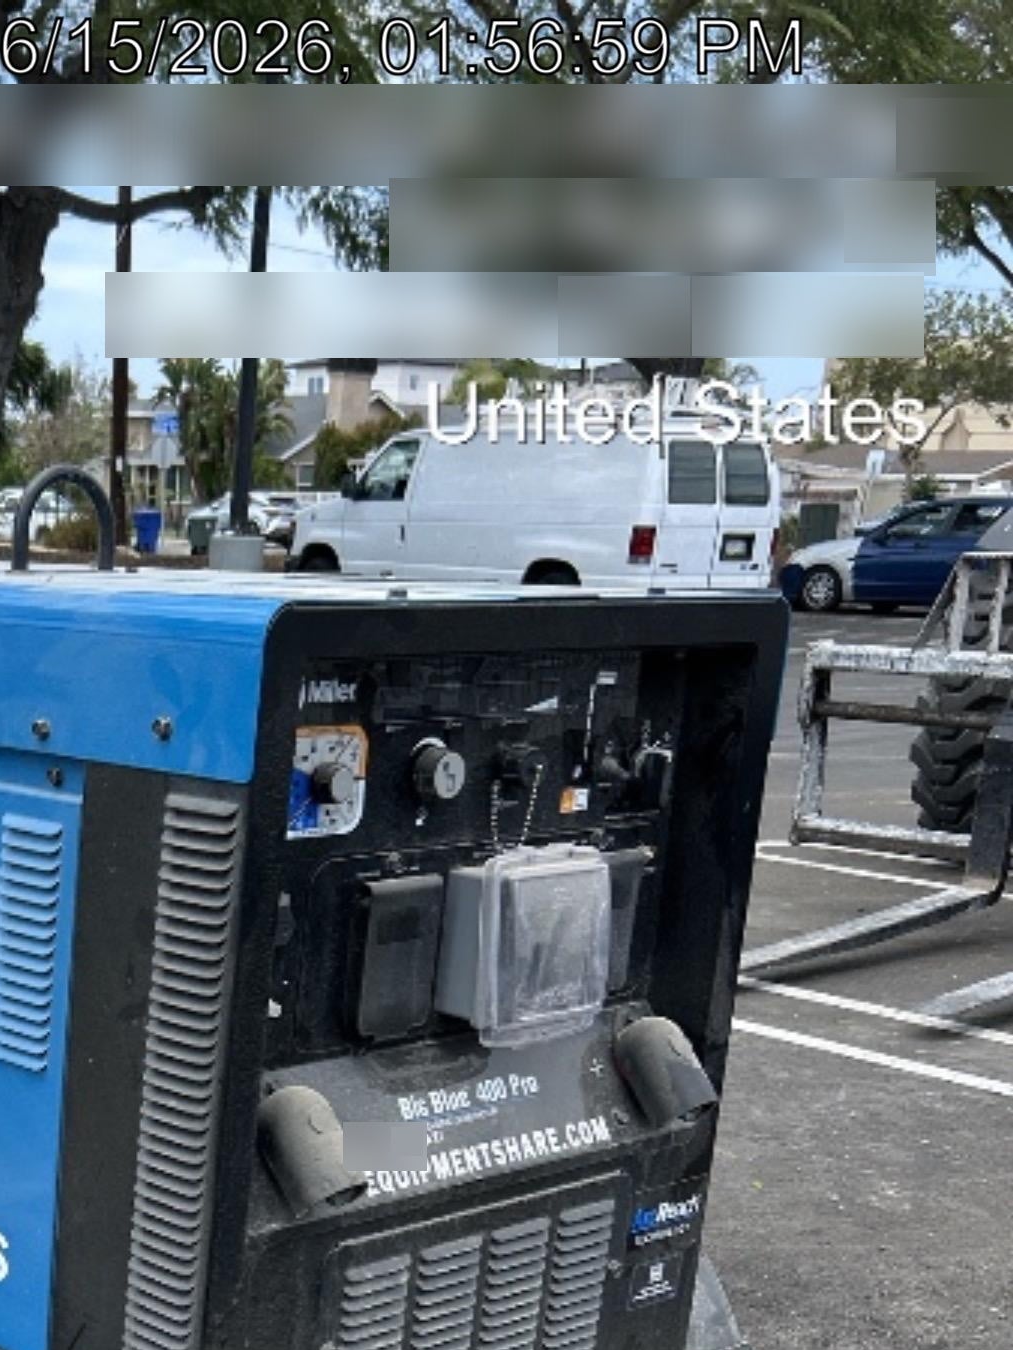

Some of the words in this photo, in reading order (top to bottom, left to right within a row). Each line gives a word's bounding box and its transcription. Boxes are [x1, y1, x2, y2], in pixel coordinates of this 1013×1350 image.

[306, 678, 357, 704] Miller
[397, 1094, 429, 1121] Big
[428, 1088, 471, 1114] Blue
[508, 1073, 539, 1097] Pro
